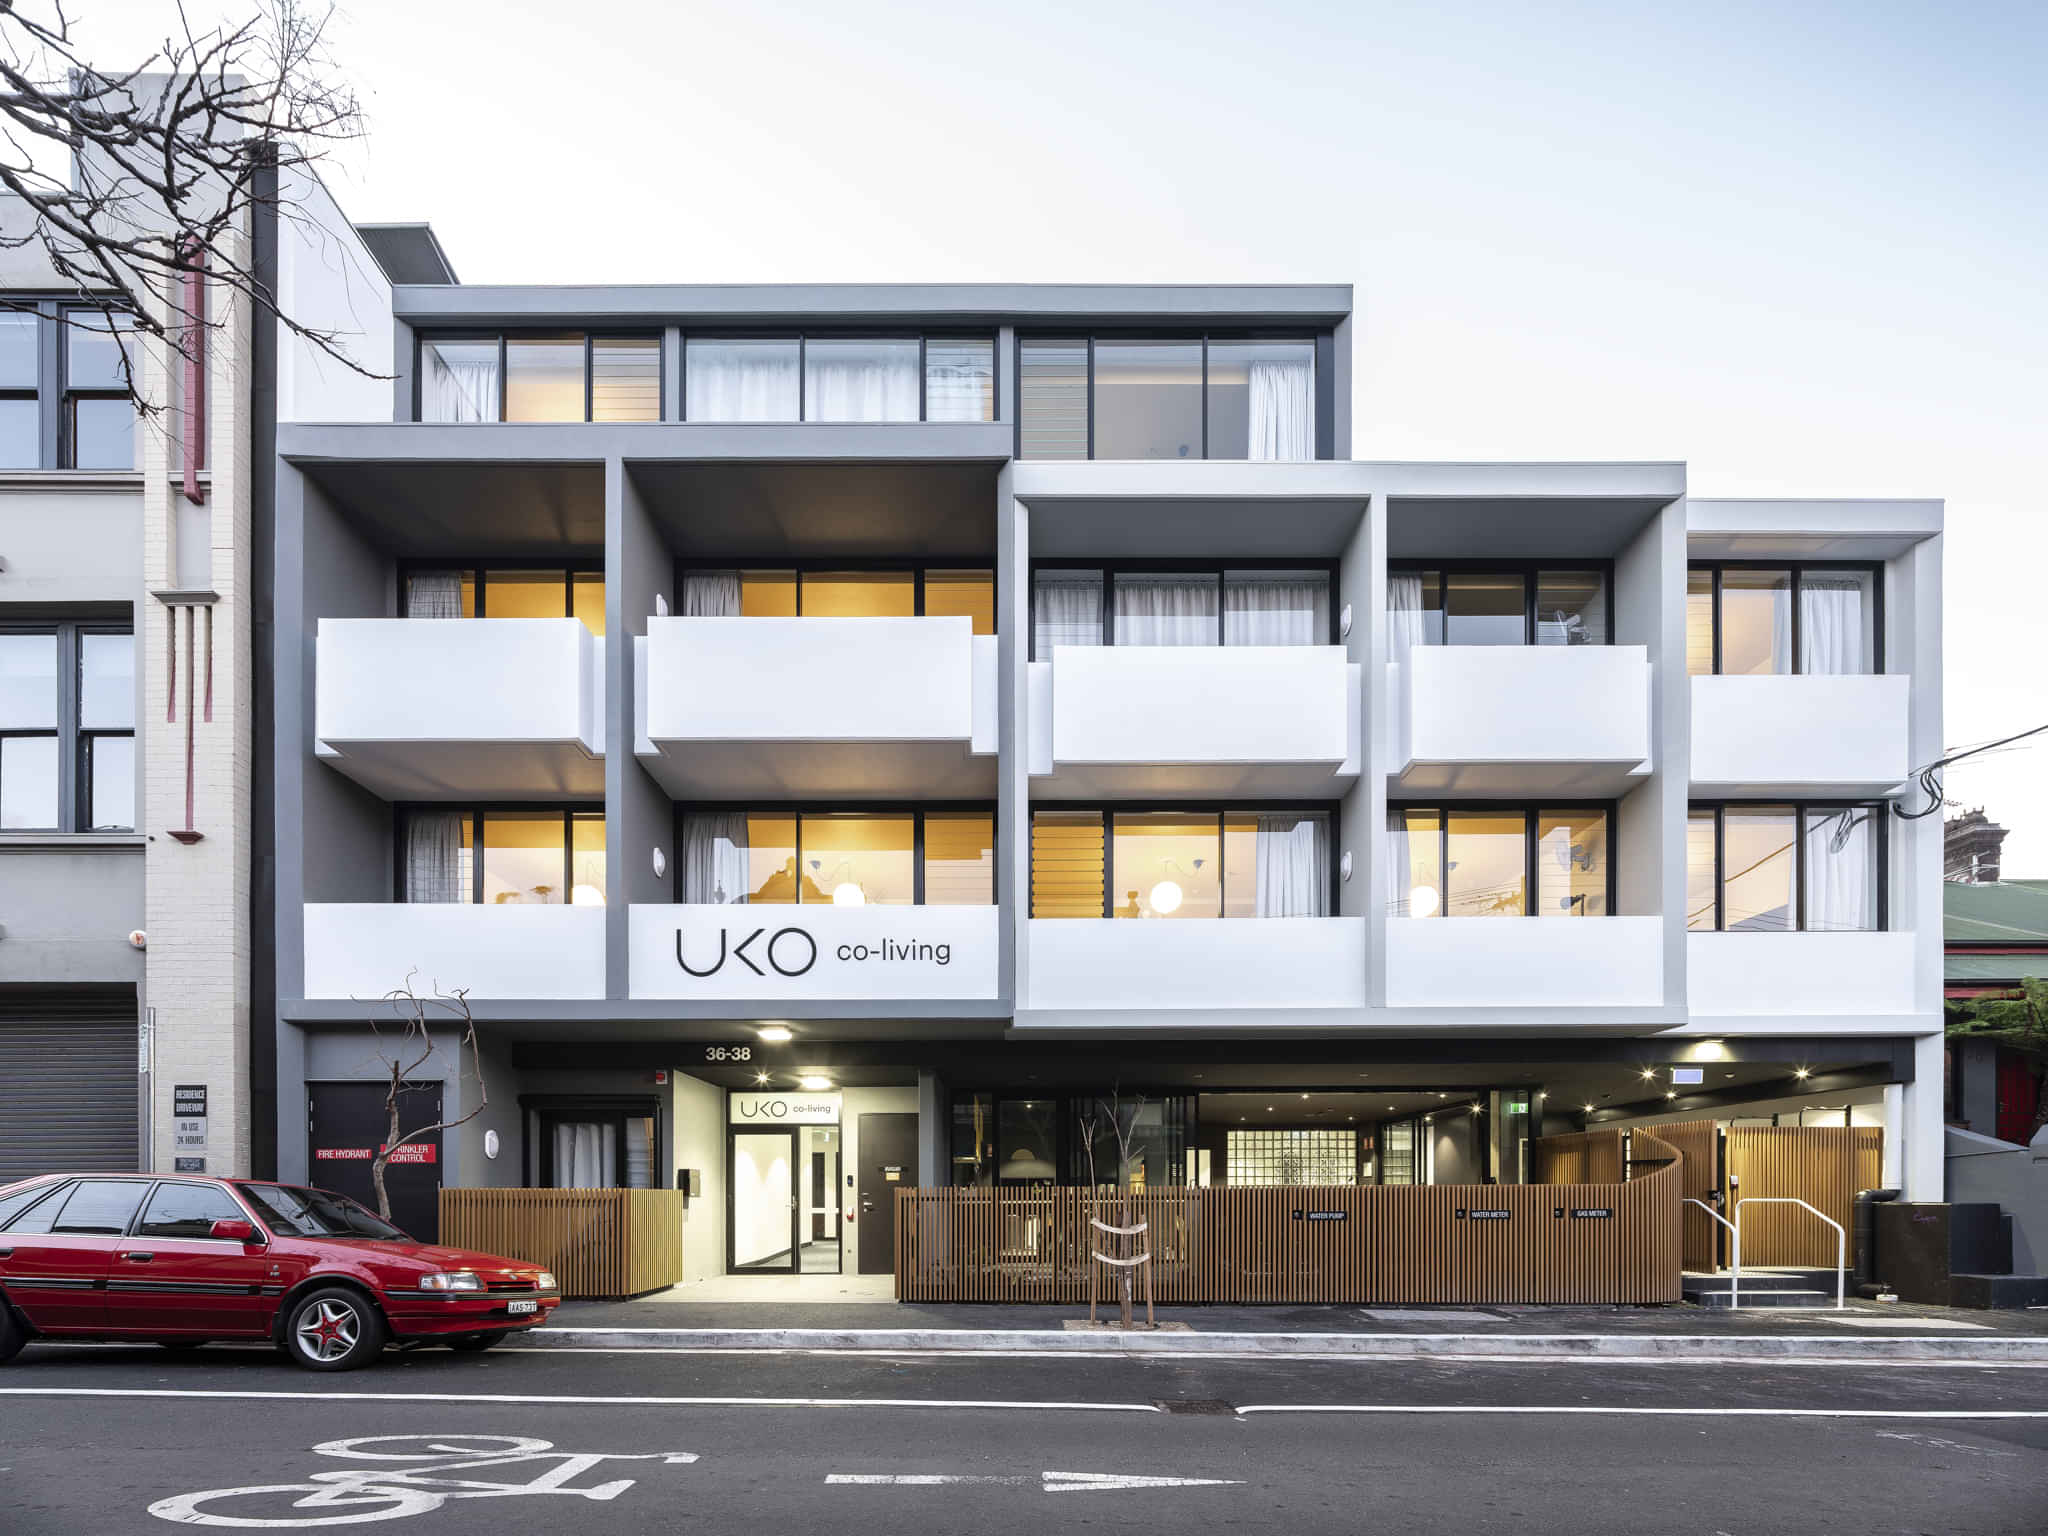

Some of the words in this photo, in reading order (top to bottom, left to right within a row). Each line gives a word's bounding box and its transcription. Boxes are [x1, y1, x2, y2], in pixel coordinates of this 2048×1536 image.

[676, 927, 817, 977] UKO
[837, 938, 951, 965] co-living
[705, 1047, 751, 1061] 36-38
[175, 1102, 205, 1113] DRIVEWAY
[740, 1100, 788, 1118] UKO
[792, 1104, 832, 1114] co-living
[188, 1122, 200, 1132] USE
[177, 1135, 184, 1145] 24
[185, 1135, 204, 1145] HOURS
[318, 1150, 334, 1160] FIRE
[335, 1149, 369, 1160] HYDRANT
[391, 1153, 425, 1163] CONTROL
[1310, 1212, 1328, 1220] WATER
[1471, 1211, 1490, 1219] WATER
[1490, 1211, 1509, 1219] METER
[1577, 1209, 1588, 1217] GAS
[1588, 1209, 1608, 1217] METER
